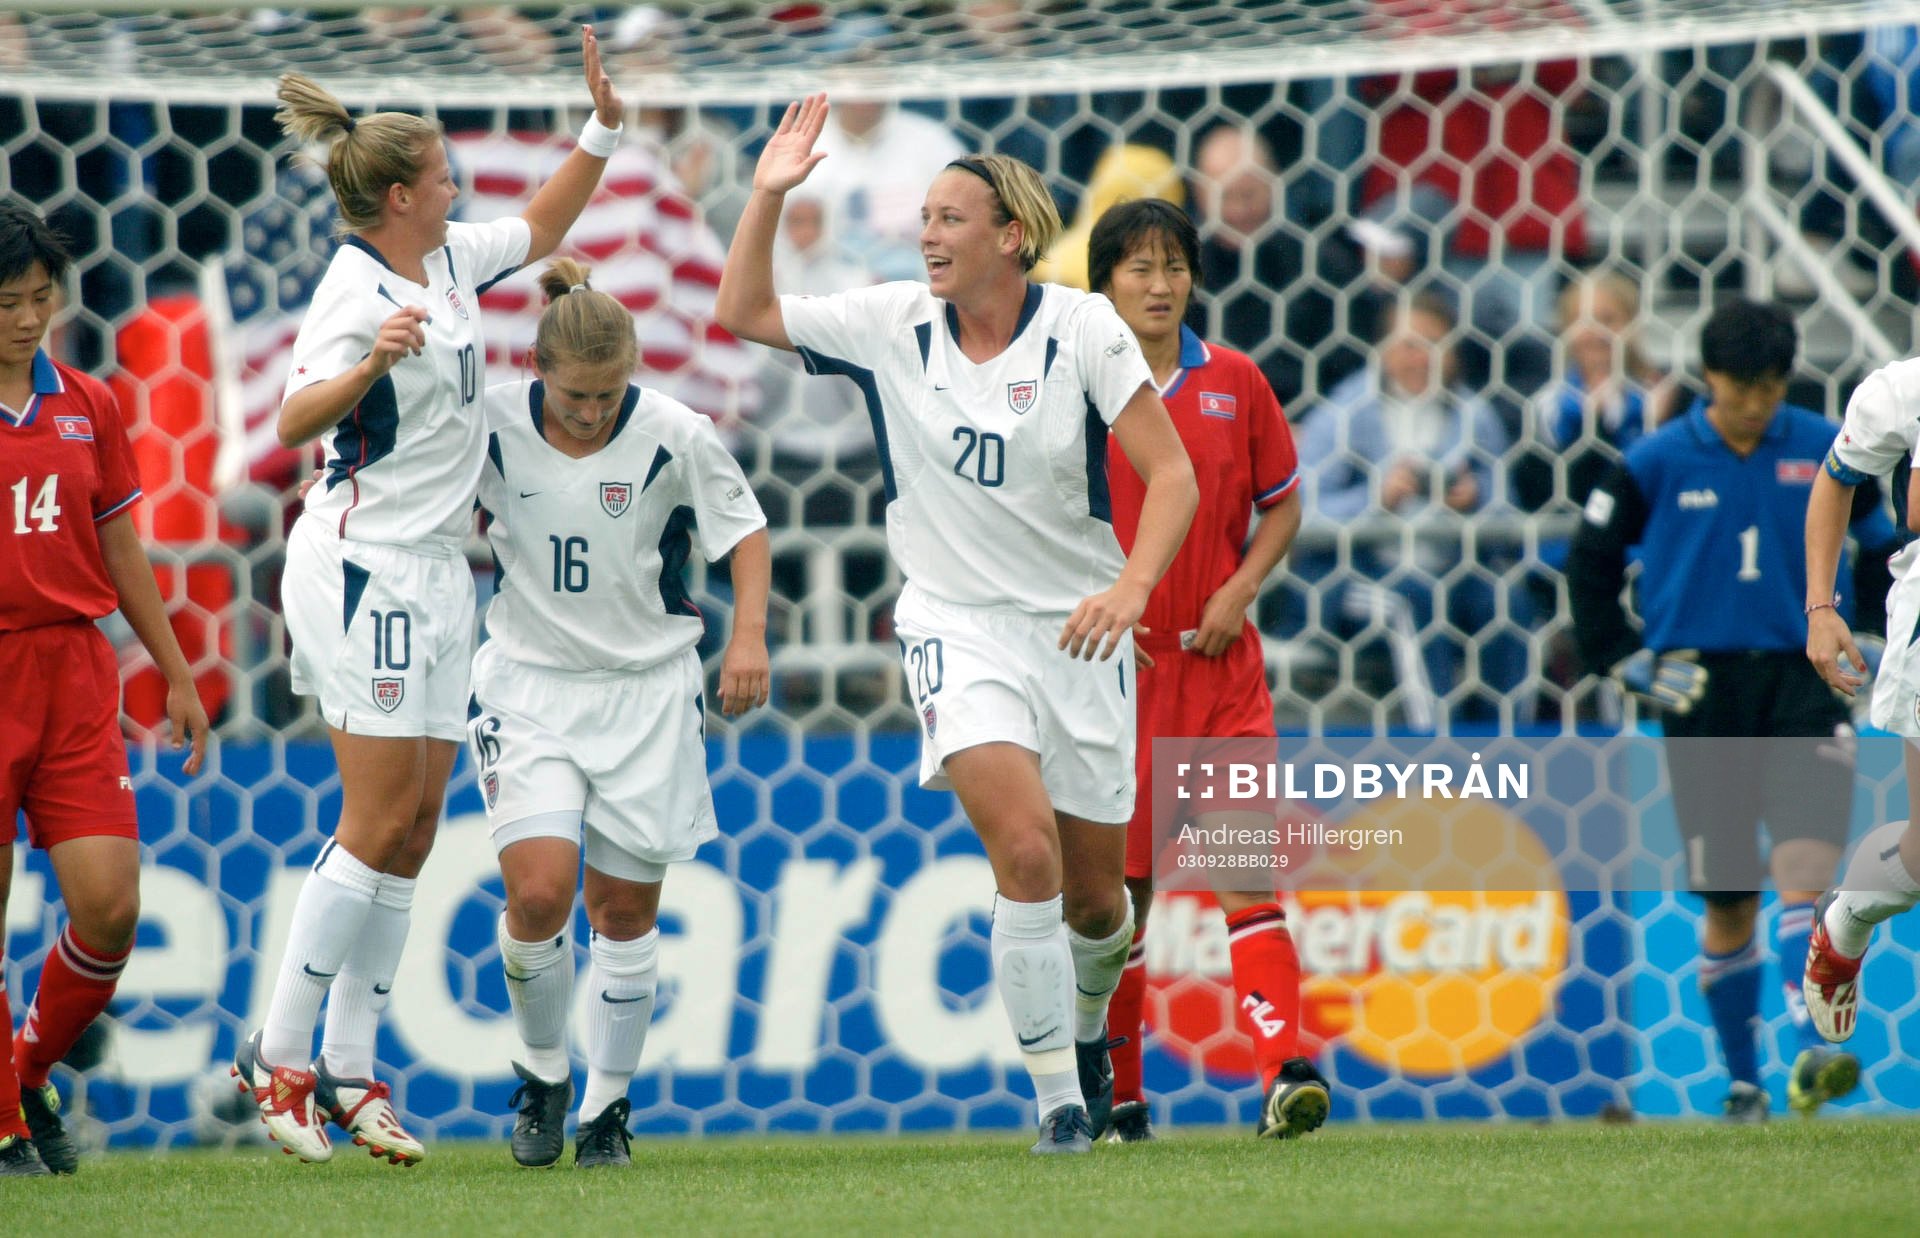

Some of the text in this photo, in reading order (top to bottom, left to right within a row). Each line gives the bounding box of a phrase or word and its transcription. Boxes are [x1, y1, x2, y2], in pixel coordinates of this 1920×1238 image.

[457, 343, 476, 407] 10
[952, 425, 1006, 487] 20
[10, 473, 61, 534] 14
[549, 534, 589, 593] 16
[1737, 525, 1762, 582] 1
[370, 609, 411, 671] 10
[911, 637, 944, 705] 20
[475, 716, 502, 772] 16
[1145, 890, 1559, 976] MaerCard
[1241, 992, 1287, 1039] FILA
